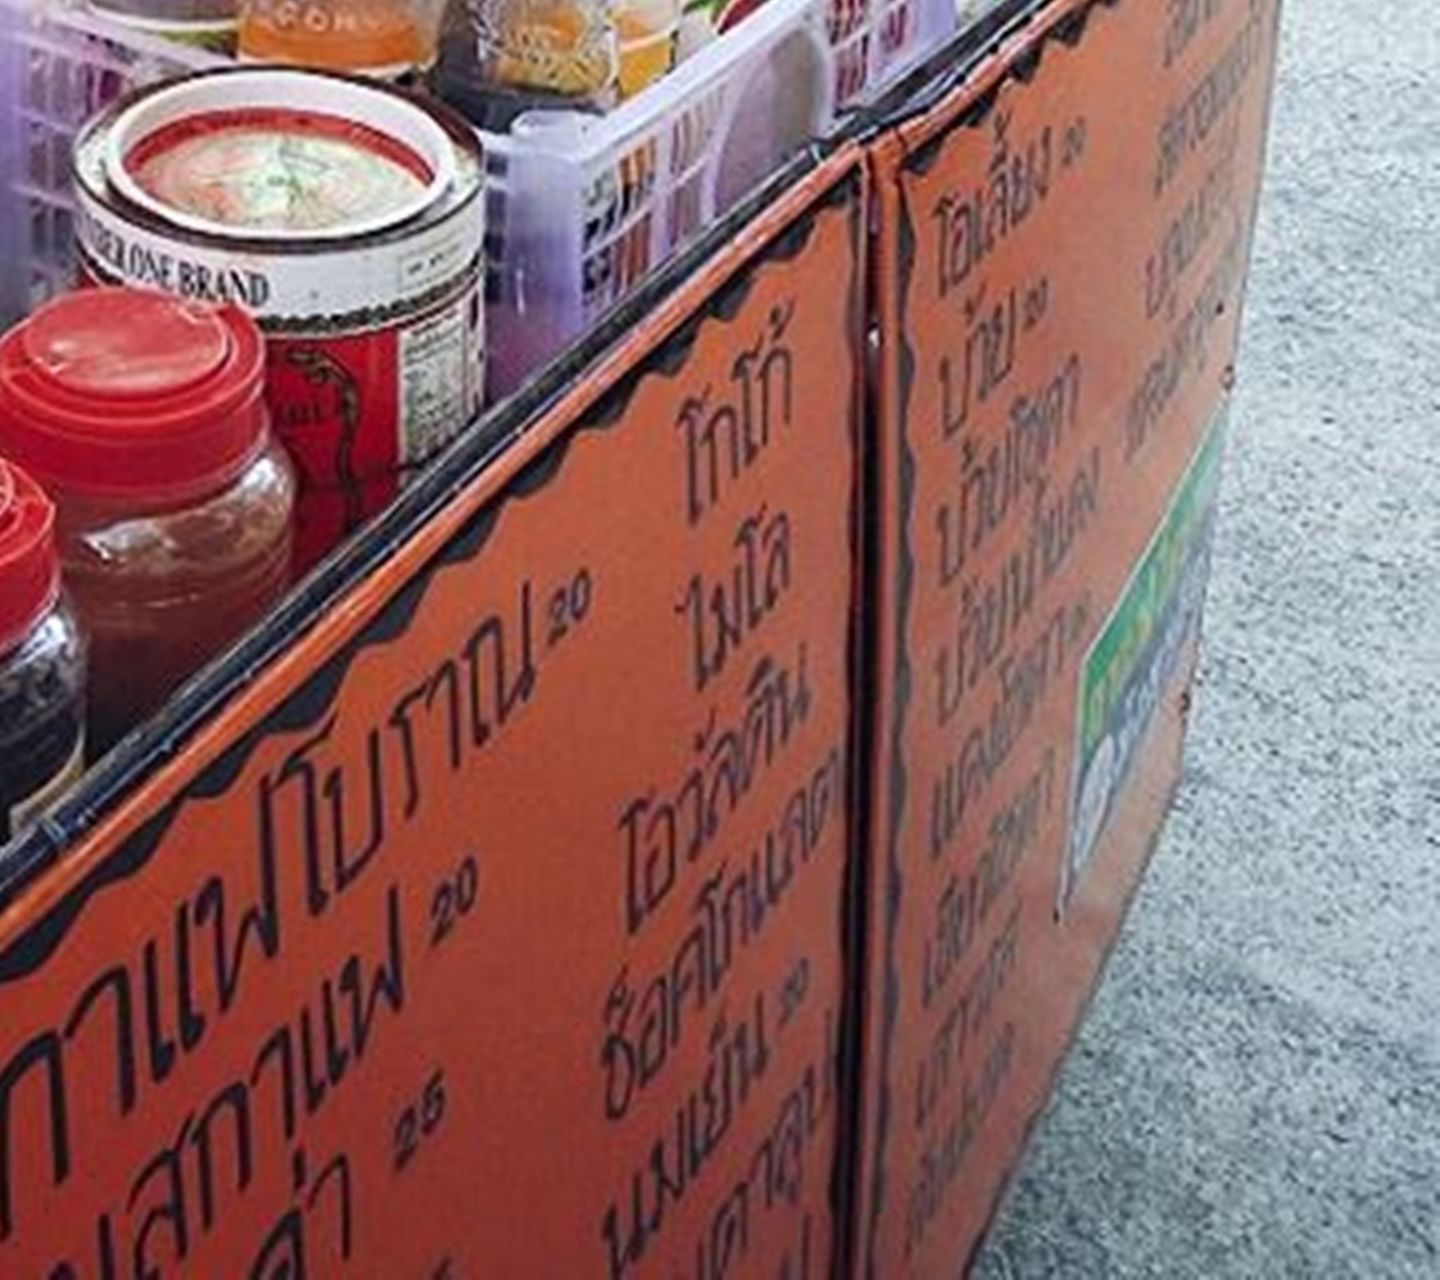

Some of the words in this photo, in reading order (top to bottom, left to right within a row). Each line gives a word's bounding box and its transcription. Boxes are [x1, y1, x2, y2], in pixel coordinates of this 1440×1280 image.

[130, 240, 174, 286] ONE
[177, 260, 271, 308] BRAND
[931, 110, 1051, 298] โอเลี้ยง
[674, 294, 796, 528] โกโก้
[546, 567, 592, 648] 20
[673, 503, 792, 694] ไมโล
[617, 642, 812, 936] โอวัลติน
[428, 855, 479, 950] 20
[391, 1068, 449, 1175] 25
